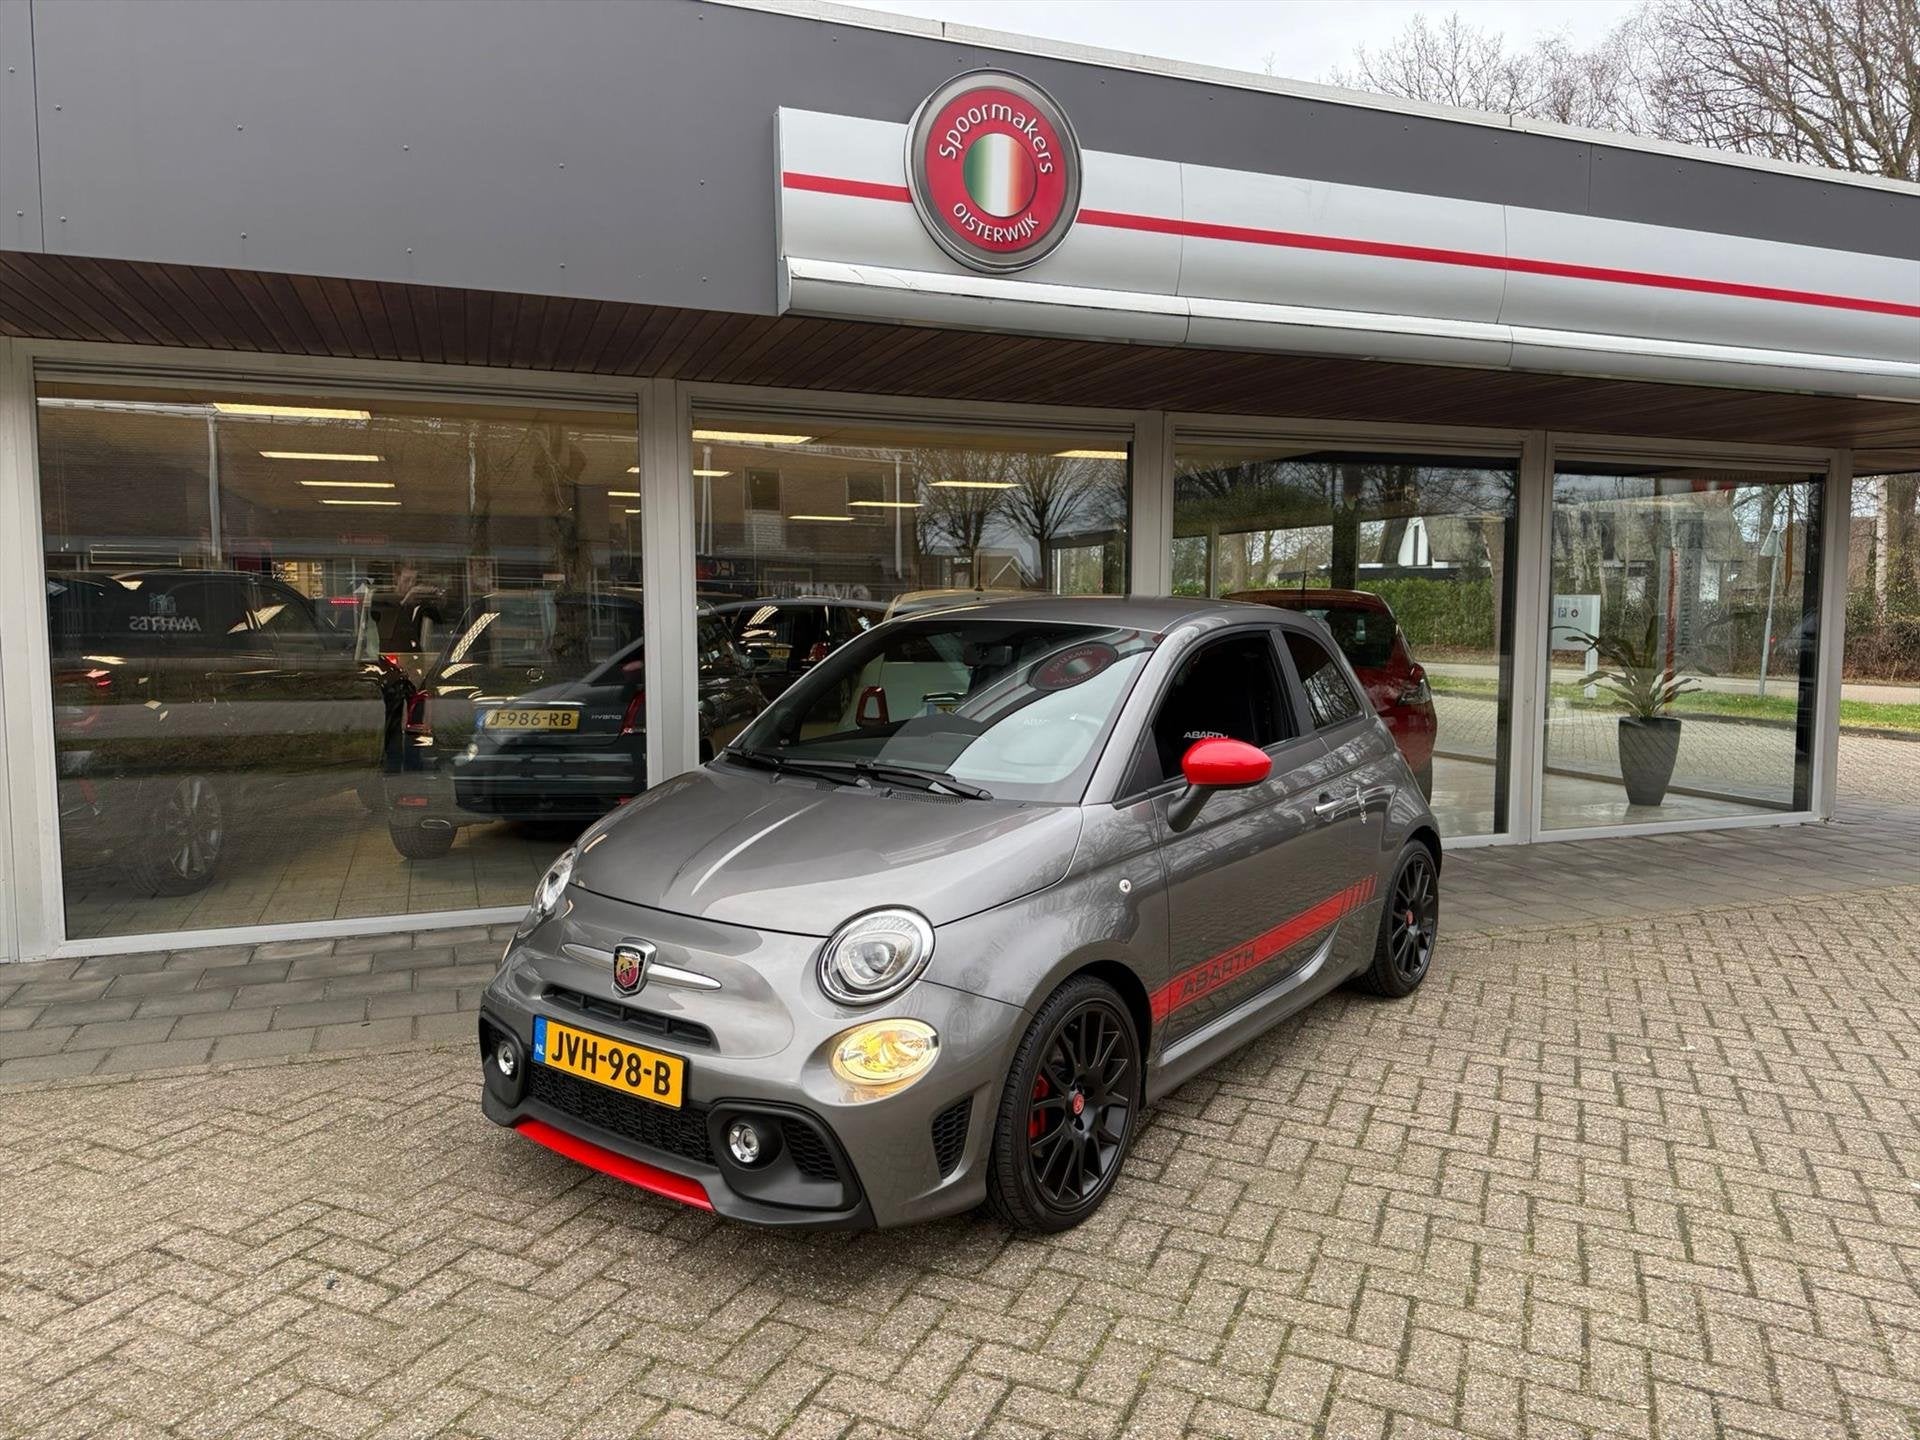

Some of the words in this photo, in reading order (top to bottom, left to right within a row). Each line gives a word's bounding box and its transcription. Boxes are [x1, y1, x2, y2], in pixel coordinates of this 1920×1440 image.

[939, 103, 1053, 174] Spoormakers
[953, 202, 1039, 242] OISTERWIJK
[490, 712, 572, 727] J-986-RB
[1182, 944, 1255, 999] ABARTH
[535, 1043, 545, 1056] NL
[551, 1030, 671, 1096] JVH-98-B
